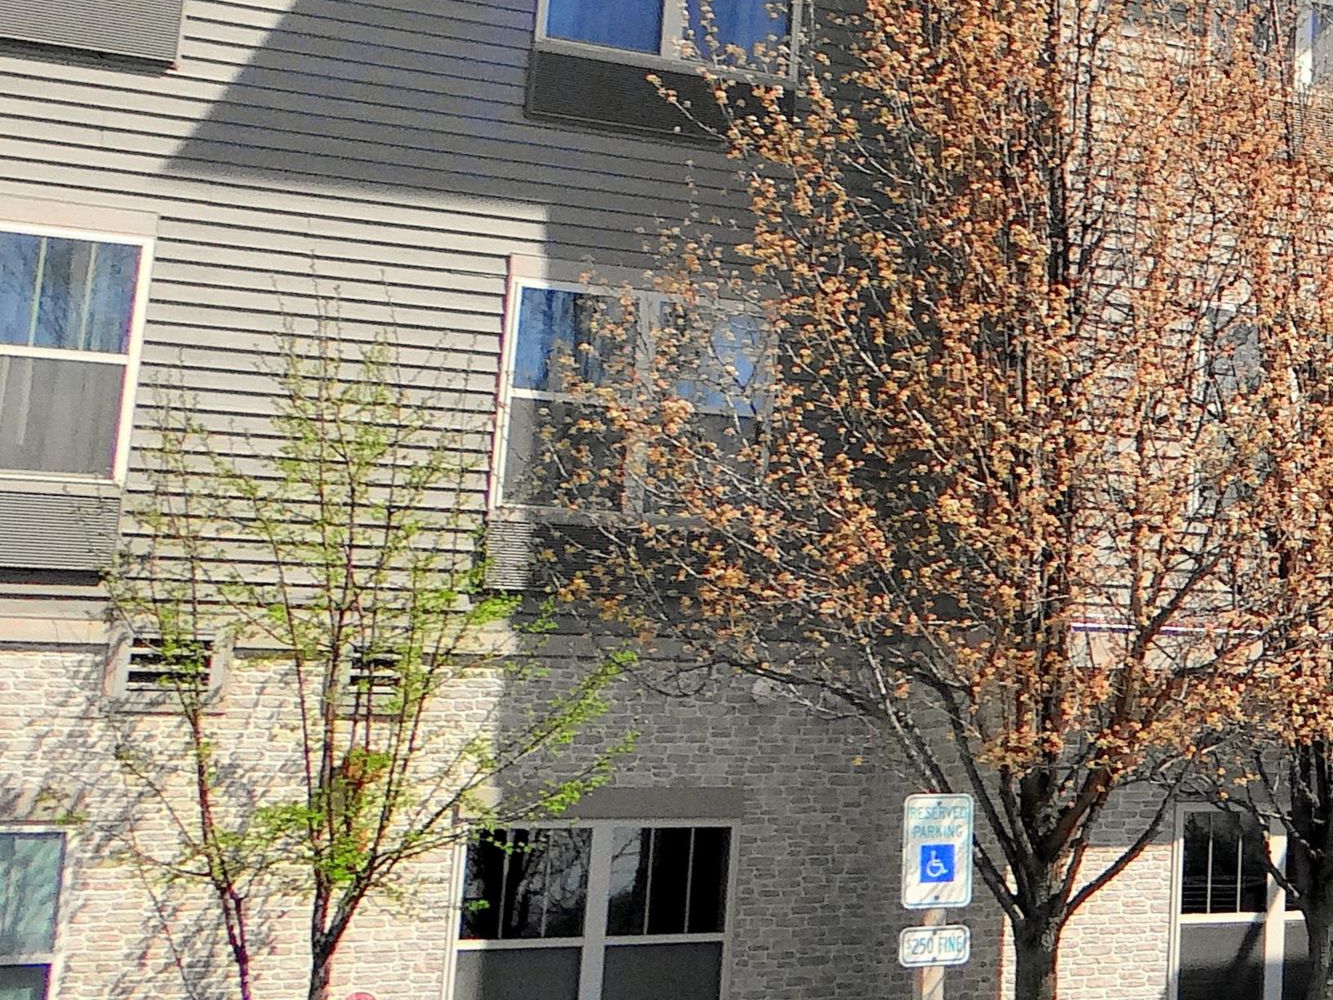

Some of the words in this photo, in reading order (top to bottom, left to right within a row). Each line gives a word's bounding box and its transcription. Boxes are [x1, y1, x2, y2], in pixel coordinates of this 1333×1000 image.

[909, 805, 969, 820] RESERVED
[912, 823, 963, 839] PARKING
[937, 935, 964, 954] FINE
